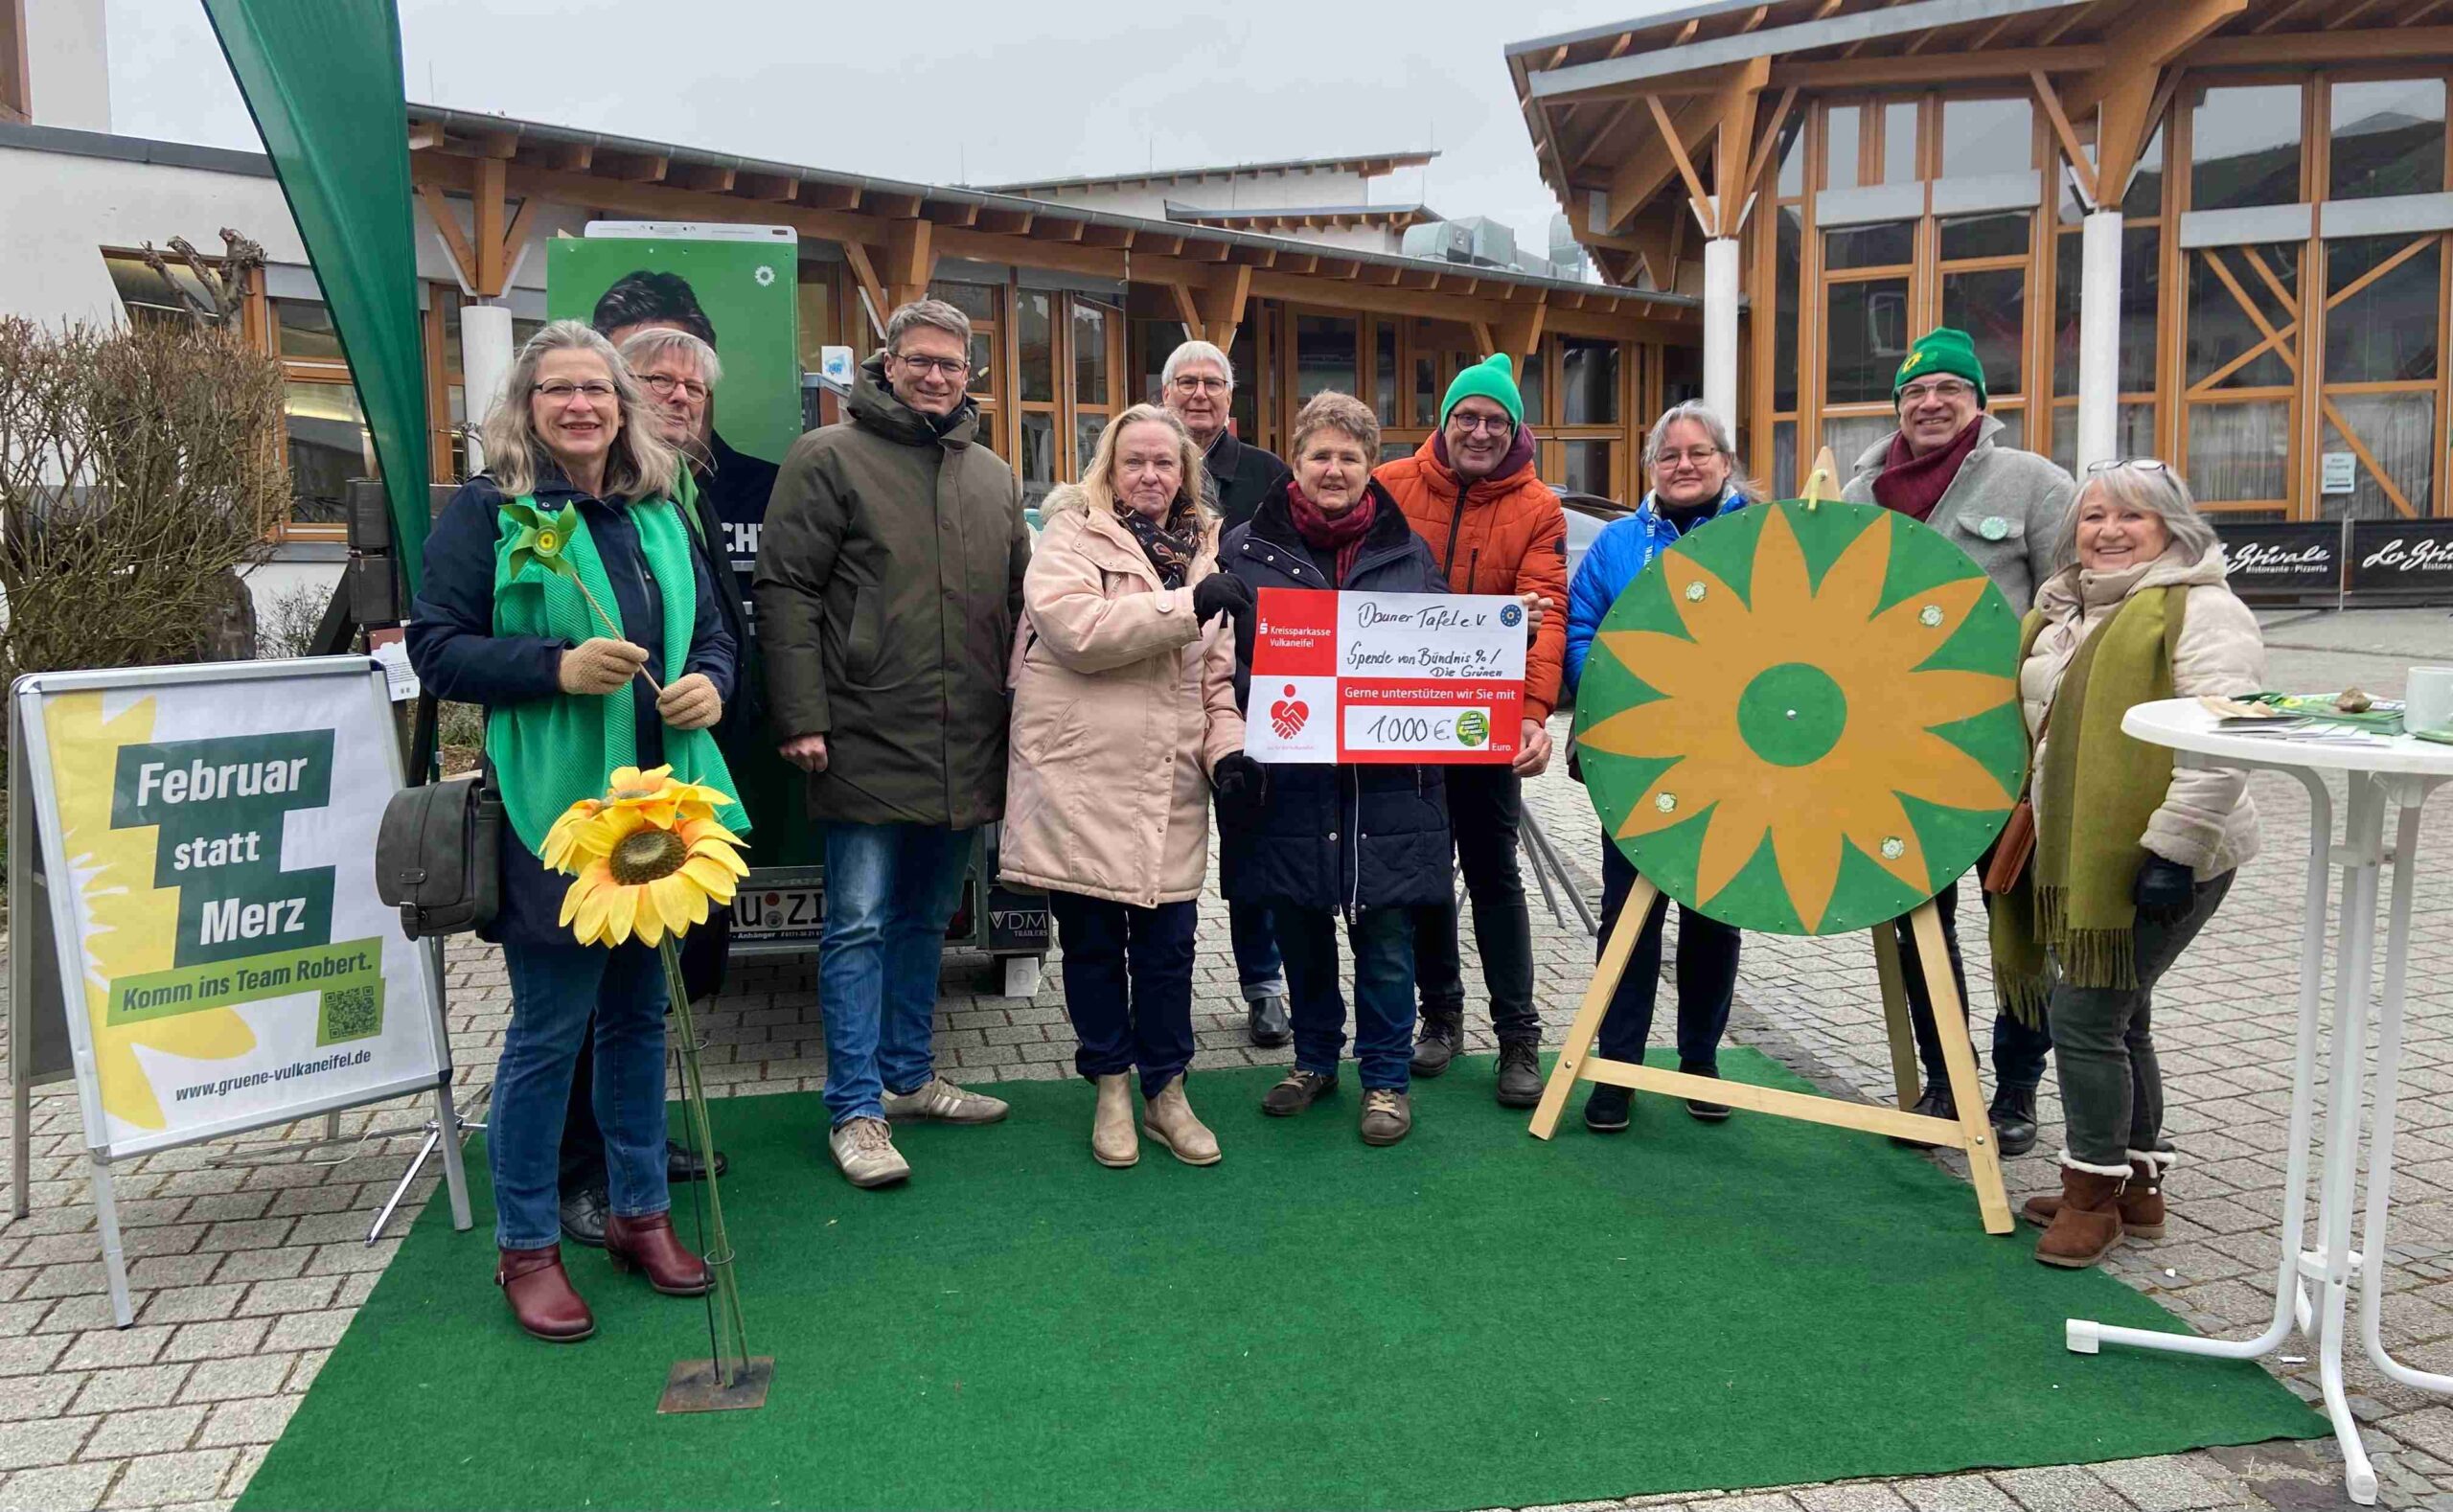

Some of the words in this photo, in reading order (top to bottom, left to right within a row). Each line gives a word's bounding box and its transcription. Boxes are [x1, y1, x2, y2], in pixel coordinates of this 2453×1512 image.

[2246, 564, 2289, 574] Ristorante
[2294, 563, 2328, 573] Pizzeria
[1416, 606, 1460, 631] Tafel
[1270, 625, 1331, 637] Kreissparkasse
[1270, 637, 1315, 648] Vulkaneifel
[1346, 640, 1394, 670] Spende
[1397, 655, 1415, 665] von
[1418, 647, 1471, 666] Bündnis
[1429, 666, 1456, 677] Die
[1460, 664, 1502, 677] Grünen
[1344, 687, 1379, 699] Gerne
[1382, 688, 1455, 699] unterstützen
[1456, 689, 1474, 699] wir
[1476, 689, 1494, 699] Sie
[1496, 689, 1516, 700] mit
[1492, 743, 1513, 752] Euro.
[137, 757, 308, 807] Februar
[173, 831, 261, 871] statt
[200, 897, 307, 946] Merz
[989, 909, 1047, 929] VDM
[123, 983, 192, 1012] Komm
[198, 974, 230, 998] ins
[236, 966, 291, 992] Team
[297, 951, 373, 982] Robert.
[175, 1049, 372, 1102] www.gruene-vulkaneifel.de
